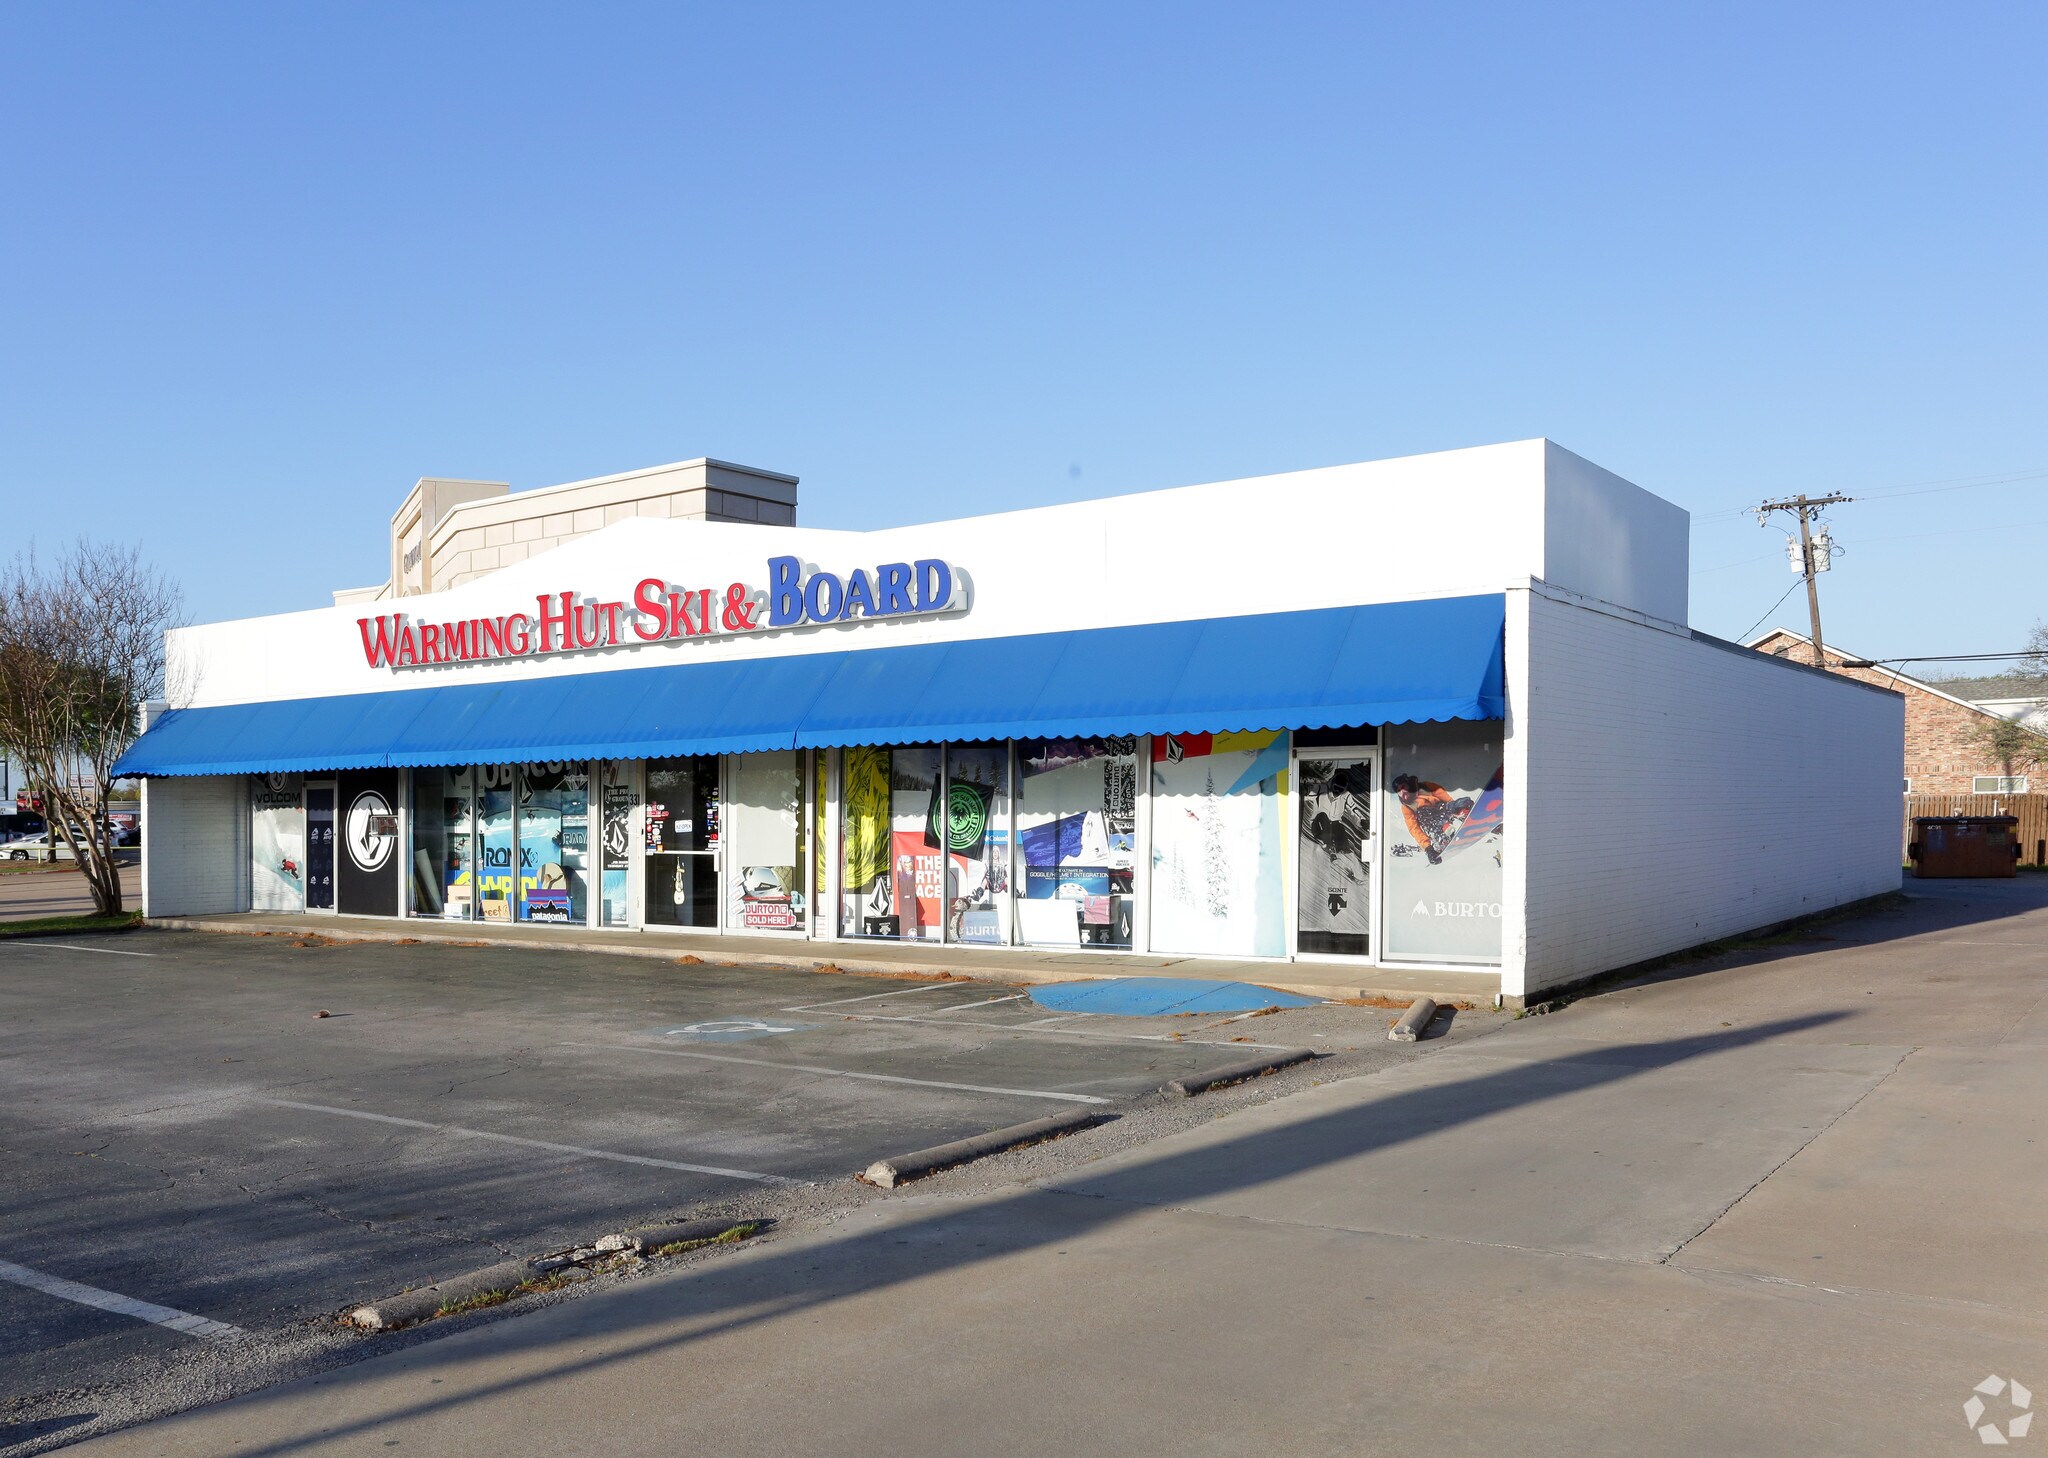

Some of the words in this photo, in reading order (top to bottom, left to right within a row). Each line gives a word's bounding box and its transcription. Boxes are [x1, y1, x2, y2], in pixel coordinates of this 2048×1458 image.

[356, 612, 532, 669] WARMING
[536, 590, 627, 653] HUT
[632, 577, 715, 641] SKI
[721, 581, 760, 632] &
[767, 555, 955, 627] BOARD
[256, 792, 301, 804] VOLCOM
[916, 855, 942, 870] THE
[916, 871, 942, 884] RTH
[916, 884, 942, 899] ACE
[745, 904, 780, 914] BURTON
[531, 911, 568, 923] patagonia
[747, 915, 768, 925] SOLD
[768, 915, 787, 925] HERE
